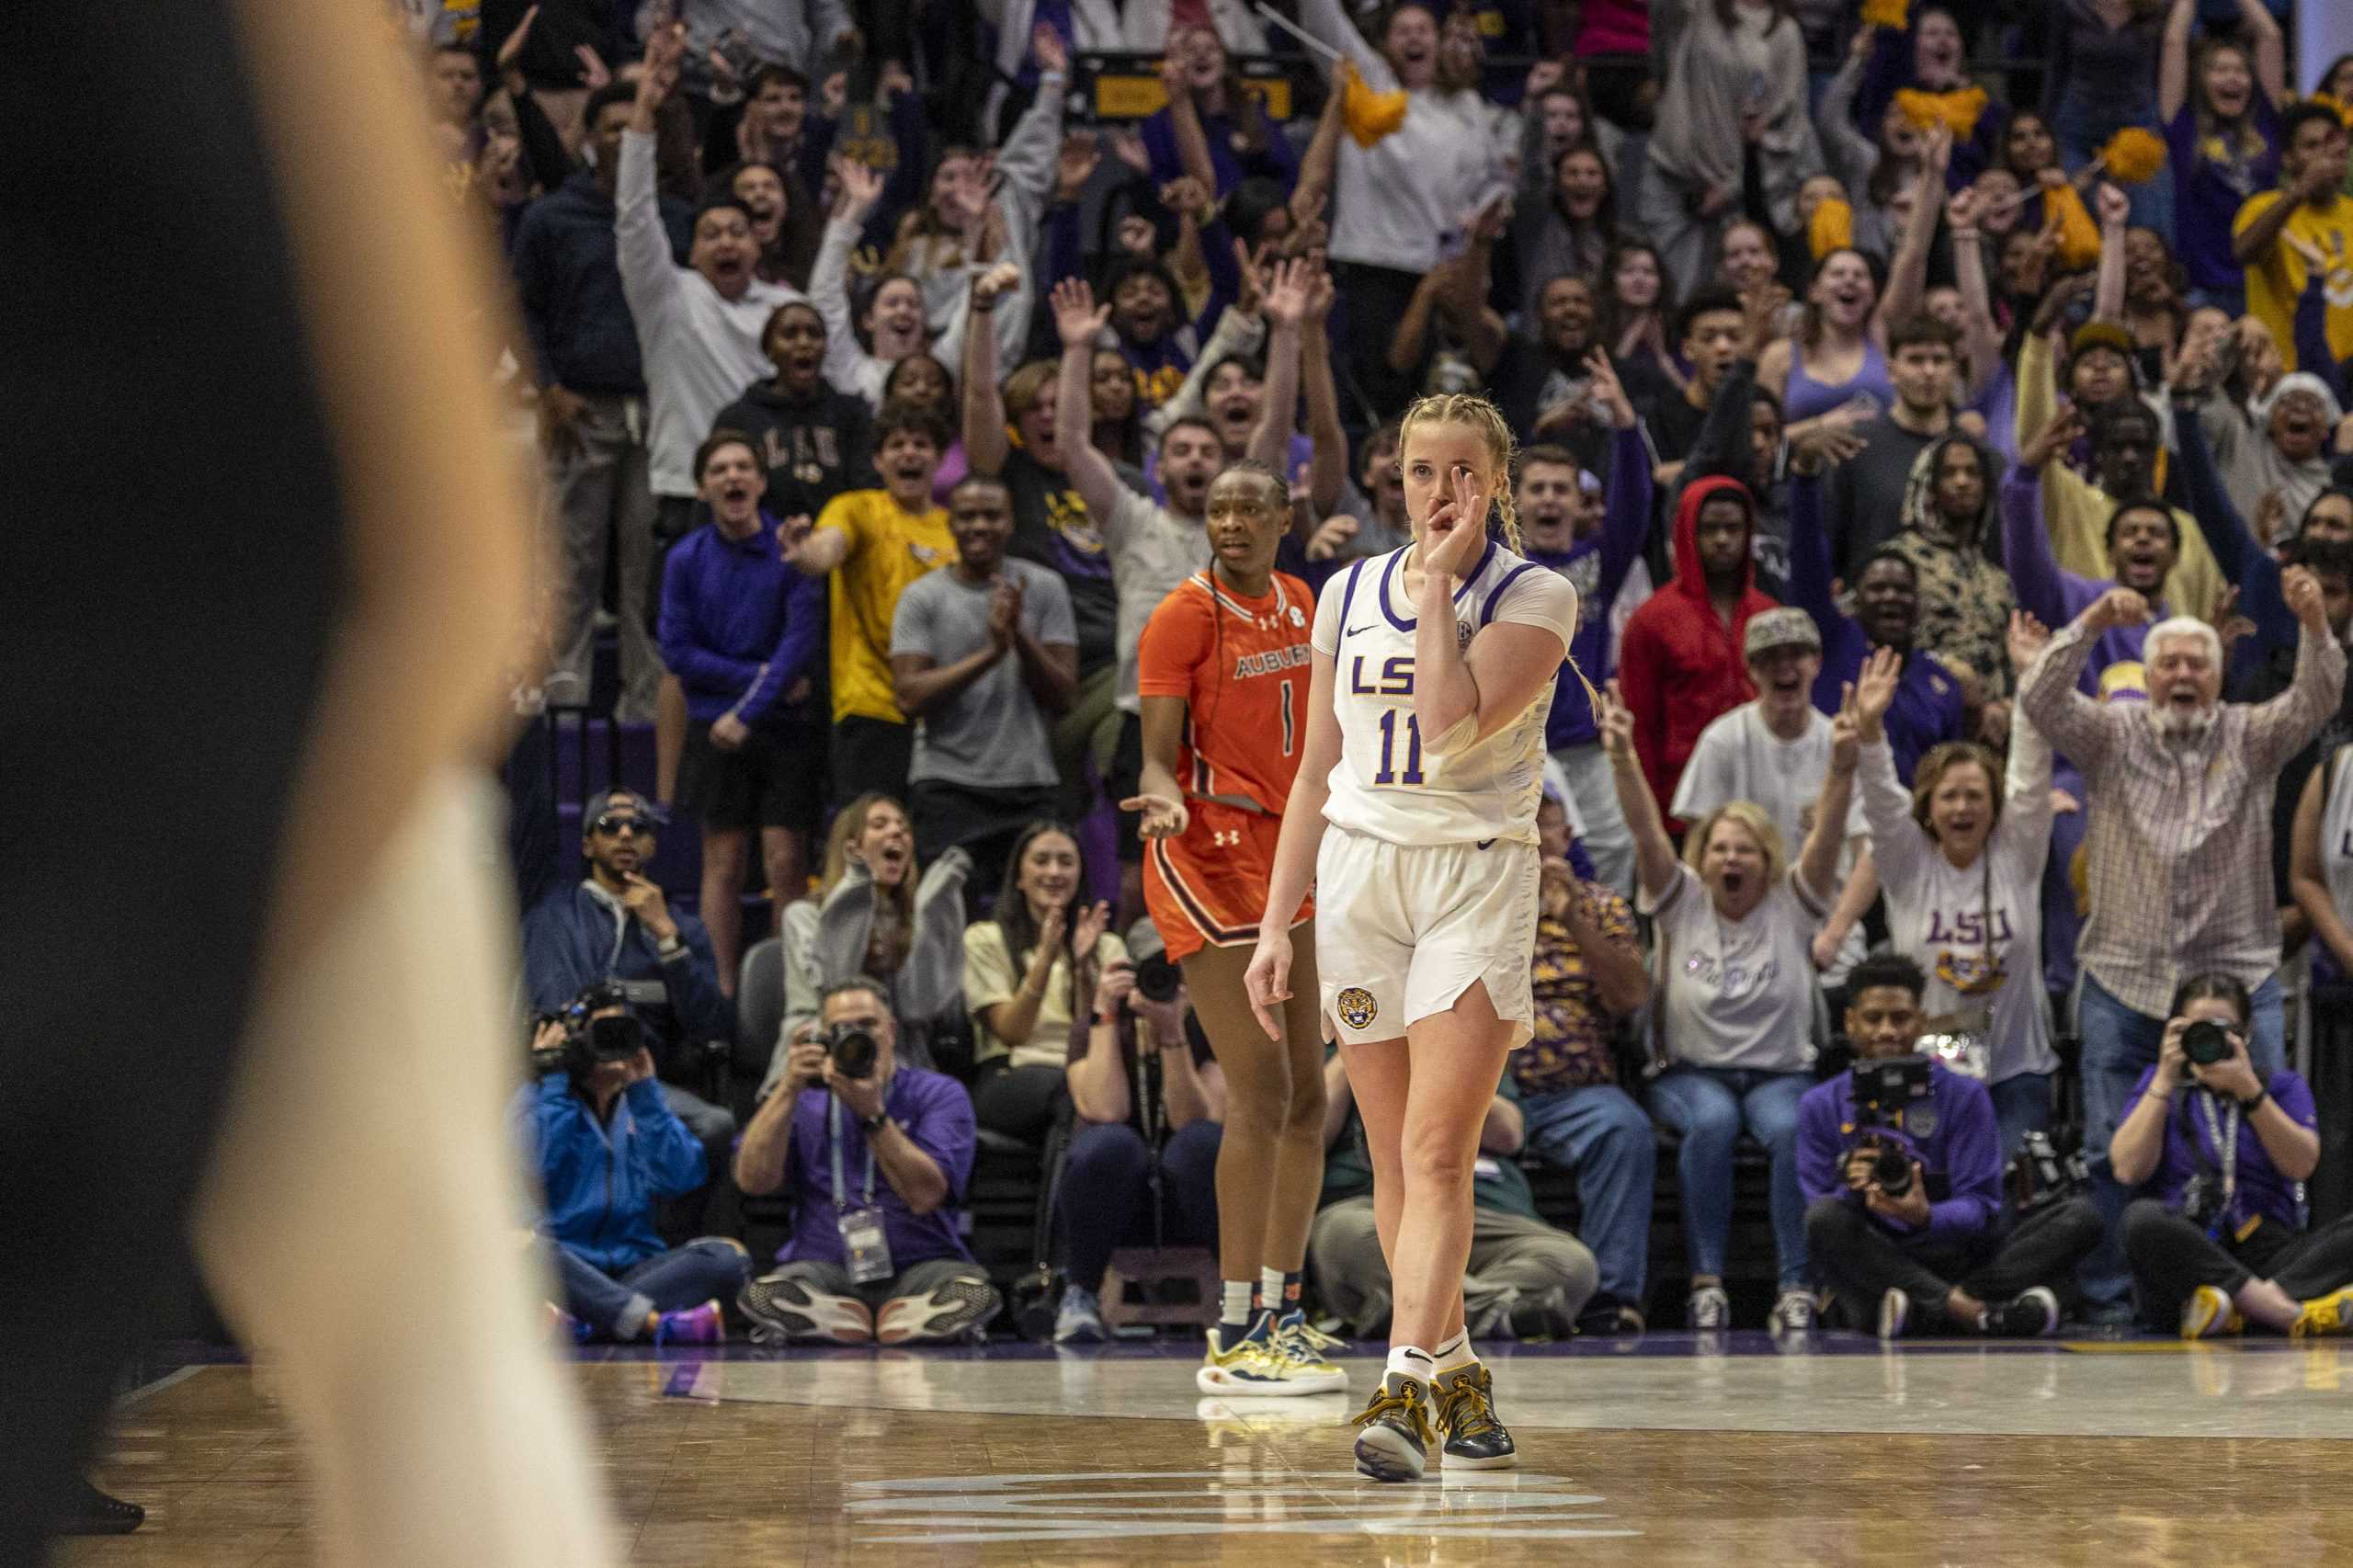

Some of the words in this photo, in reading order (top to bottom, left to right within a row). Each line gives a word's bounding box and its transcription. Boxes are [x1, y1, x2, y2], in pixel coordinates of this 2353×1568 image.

[1352, 655, 1416, 696] LS
[1280, 679, 1295, 757] 1
[1374, 708, 1426, 787] 11
[1927, 908, 2013, 945] LSU
